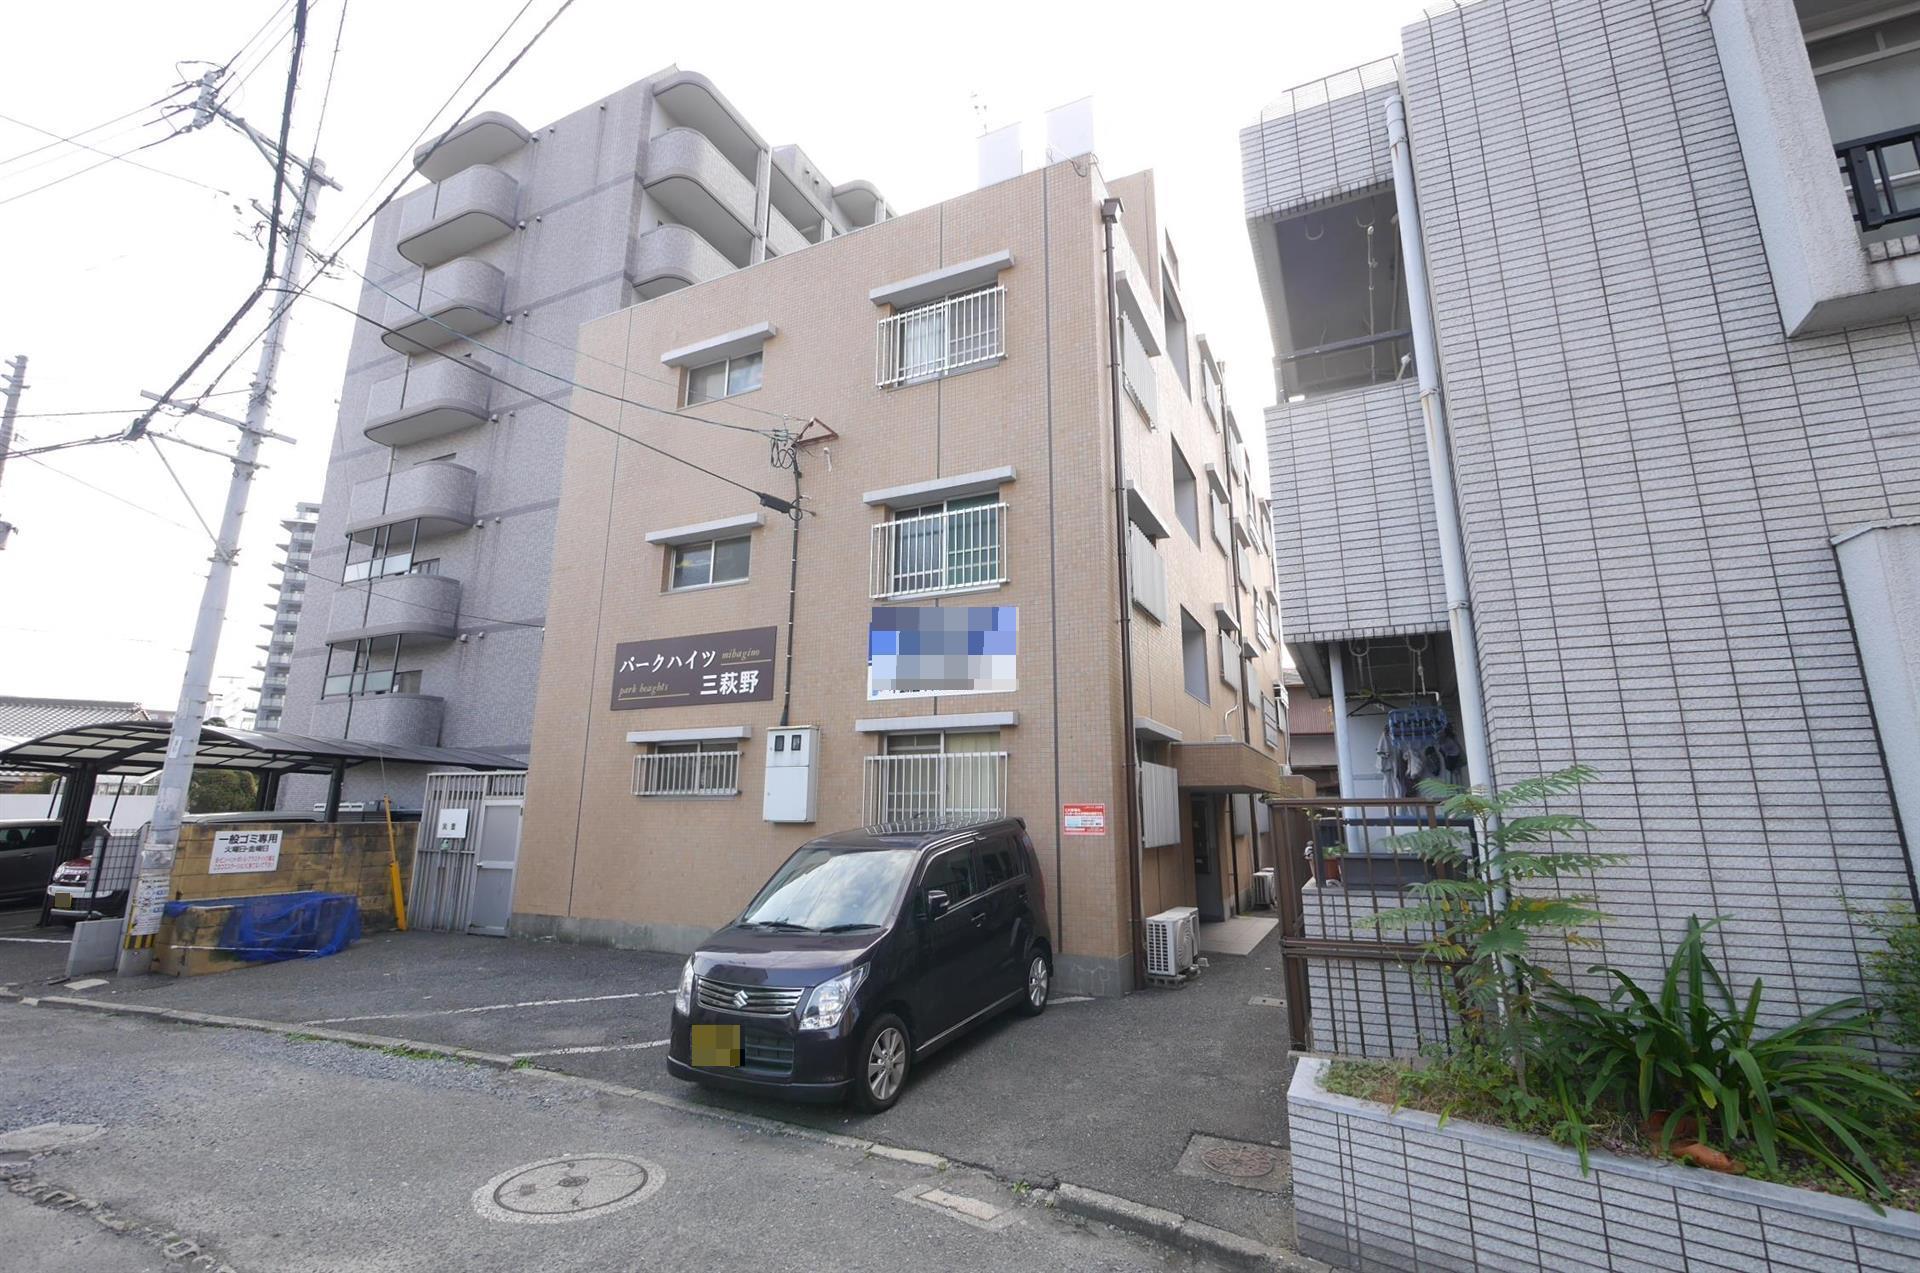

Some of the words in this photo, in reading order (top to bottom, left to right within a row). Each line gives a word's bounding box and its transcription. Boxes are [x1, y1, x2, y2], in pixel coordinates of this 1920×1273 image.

[619, 650, 716, 673] パークハイツ
[700, 670, 760, 696] 三萩野
[218, 833, 279, 844] 一般ゴミ専用
